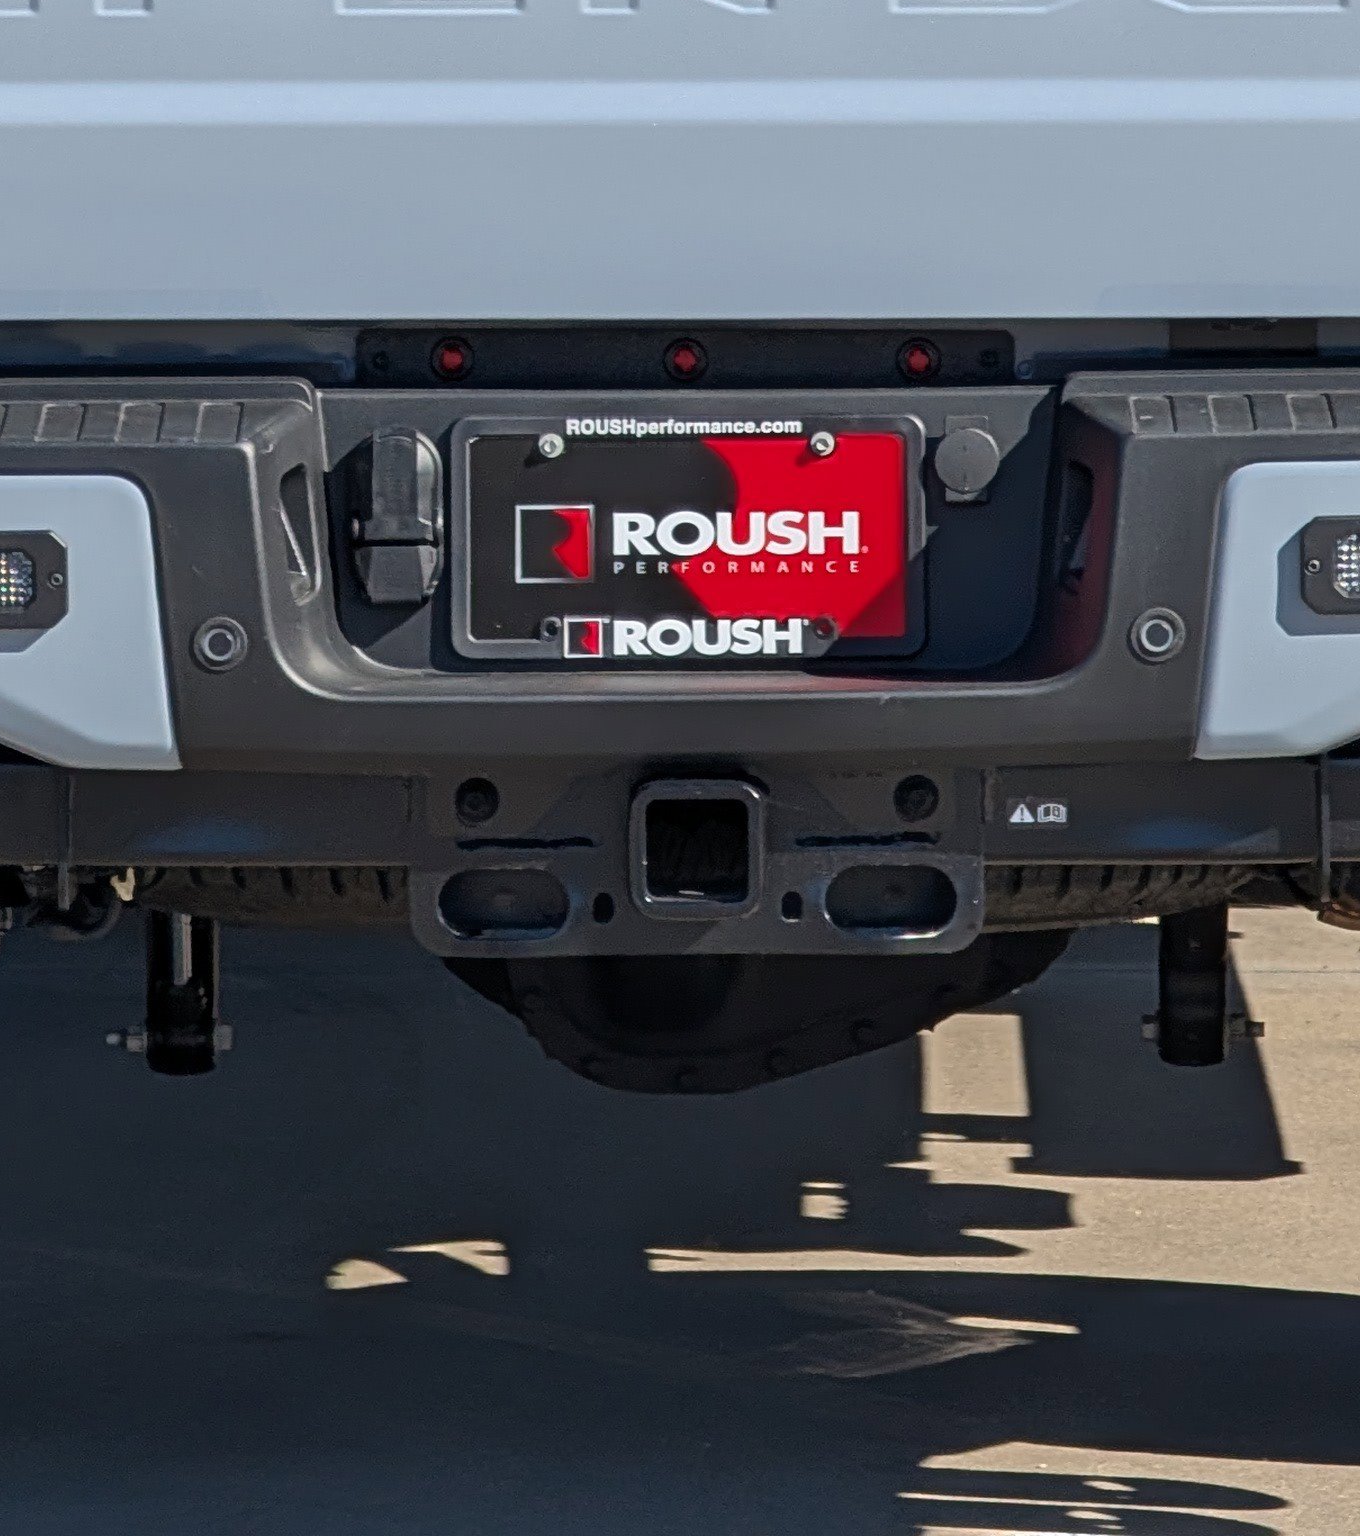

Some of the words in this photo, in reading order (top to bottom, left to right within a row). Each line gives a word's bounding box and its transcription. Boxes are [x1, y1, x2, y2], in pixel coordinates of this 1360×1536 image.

[565, 418, 803, 438] ROUSHperformance.com
[612, 510, 862, 556] ROUSH
[612, 560, 862, 574] PERFORMANCE
[612, 618, 804, 656] ROUSH
